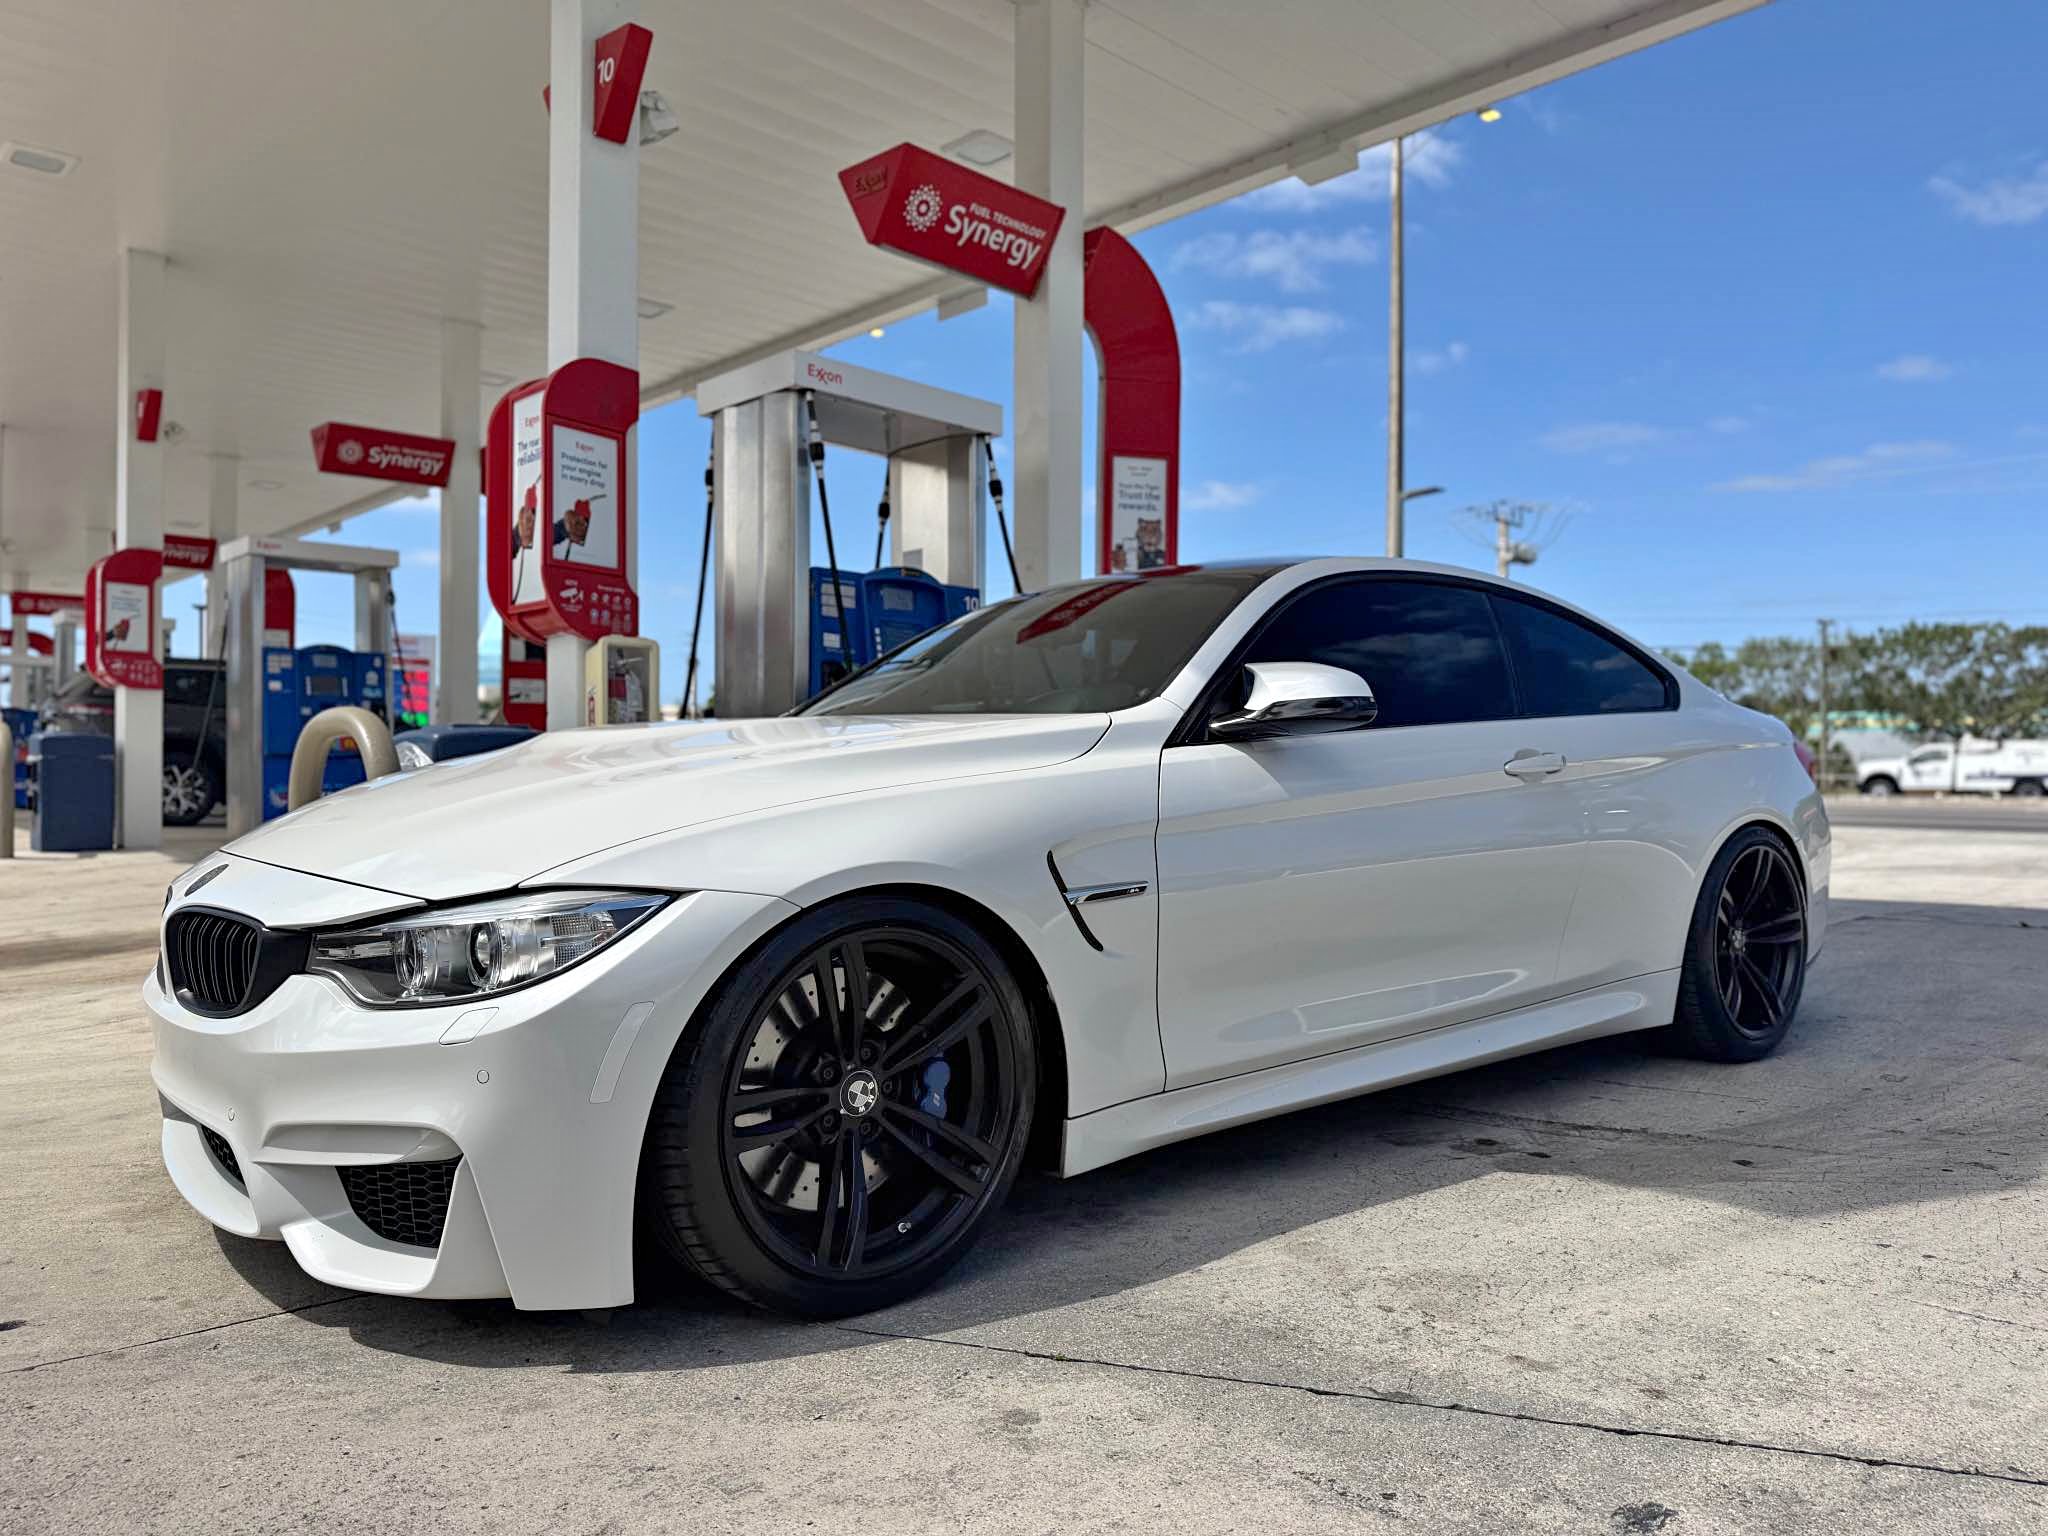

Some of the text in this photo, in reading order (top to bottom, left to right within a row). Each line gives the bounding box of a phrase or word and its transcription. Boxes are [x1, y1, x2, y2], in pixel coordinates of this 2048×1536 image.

[597, 57, 615, 85] 10
[970, 203, 1048, 239] FUEL TECHNOLOGY
[944, 204, 1042, 270] Synergy
[807, 362, 843, 385] Exxon
[367, 444, 445, 477] Synergy
[964, 596, 979, 612] 10
